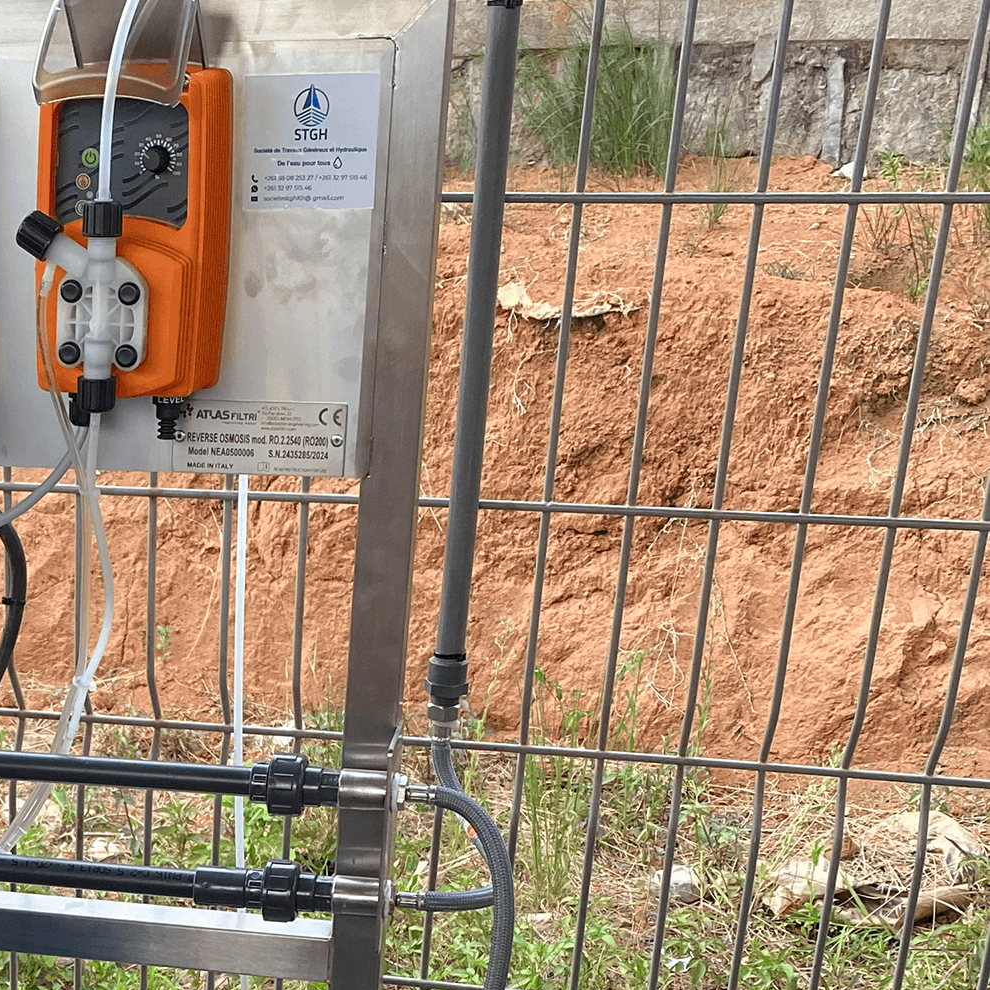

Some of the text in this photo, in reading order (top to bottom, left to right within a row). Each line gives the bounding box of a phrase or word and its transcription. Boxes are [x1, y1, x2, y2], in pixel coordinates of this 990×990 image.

[294, 128, 328, 141] STGH
[196, 410, 230, 420] ATLAS
[230, 412, 258, 421] FILTRI
[187, 432, 329, 448] REVERSE OSMOSIS mod. RO.2.2540 (RO200)
[188, 446, 209, 456] Model
[210, 447, 254, 458] NEA0500006
[214, 462, 234, 470] ITALY
